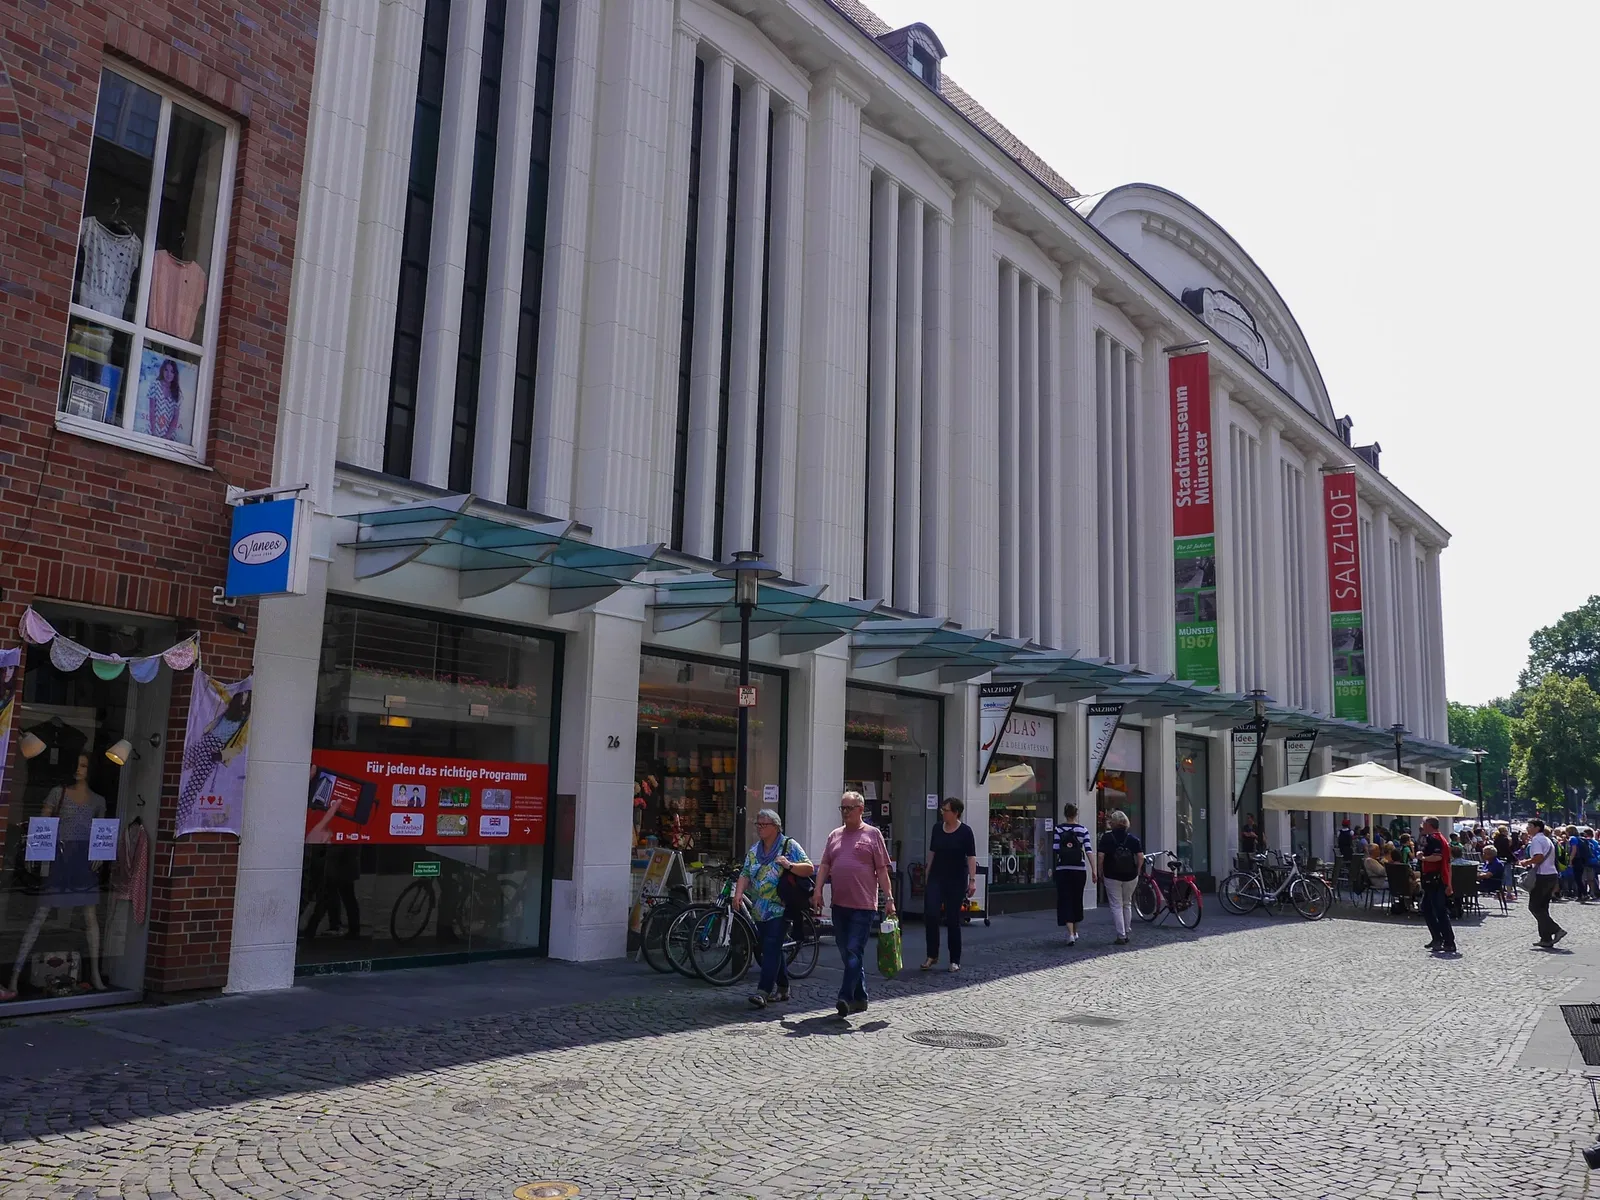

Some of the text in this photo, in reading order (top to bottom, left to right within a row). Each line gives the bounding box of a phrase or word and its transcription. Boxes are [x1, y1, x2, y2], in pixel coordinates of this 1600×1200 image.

[1174, 385, 1192, 508] Stadtmuseum
[1193, 431, 1210, 504] Münster
[237, 540, 281, 561] Vanees
[1330, 489, 1357, 599] SALZHOF
[1178, 626, 1215, 636] MÜNSTER
[1179, 634, 1215, 649] 1967
[982, 686, 1013, 694] SALZHOF
[1335, 685, 1364, 697] 1967
[607, 735, 620, 748] 26
[366, 761, 527, 783] Für jeden das richtige Programm
